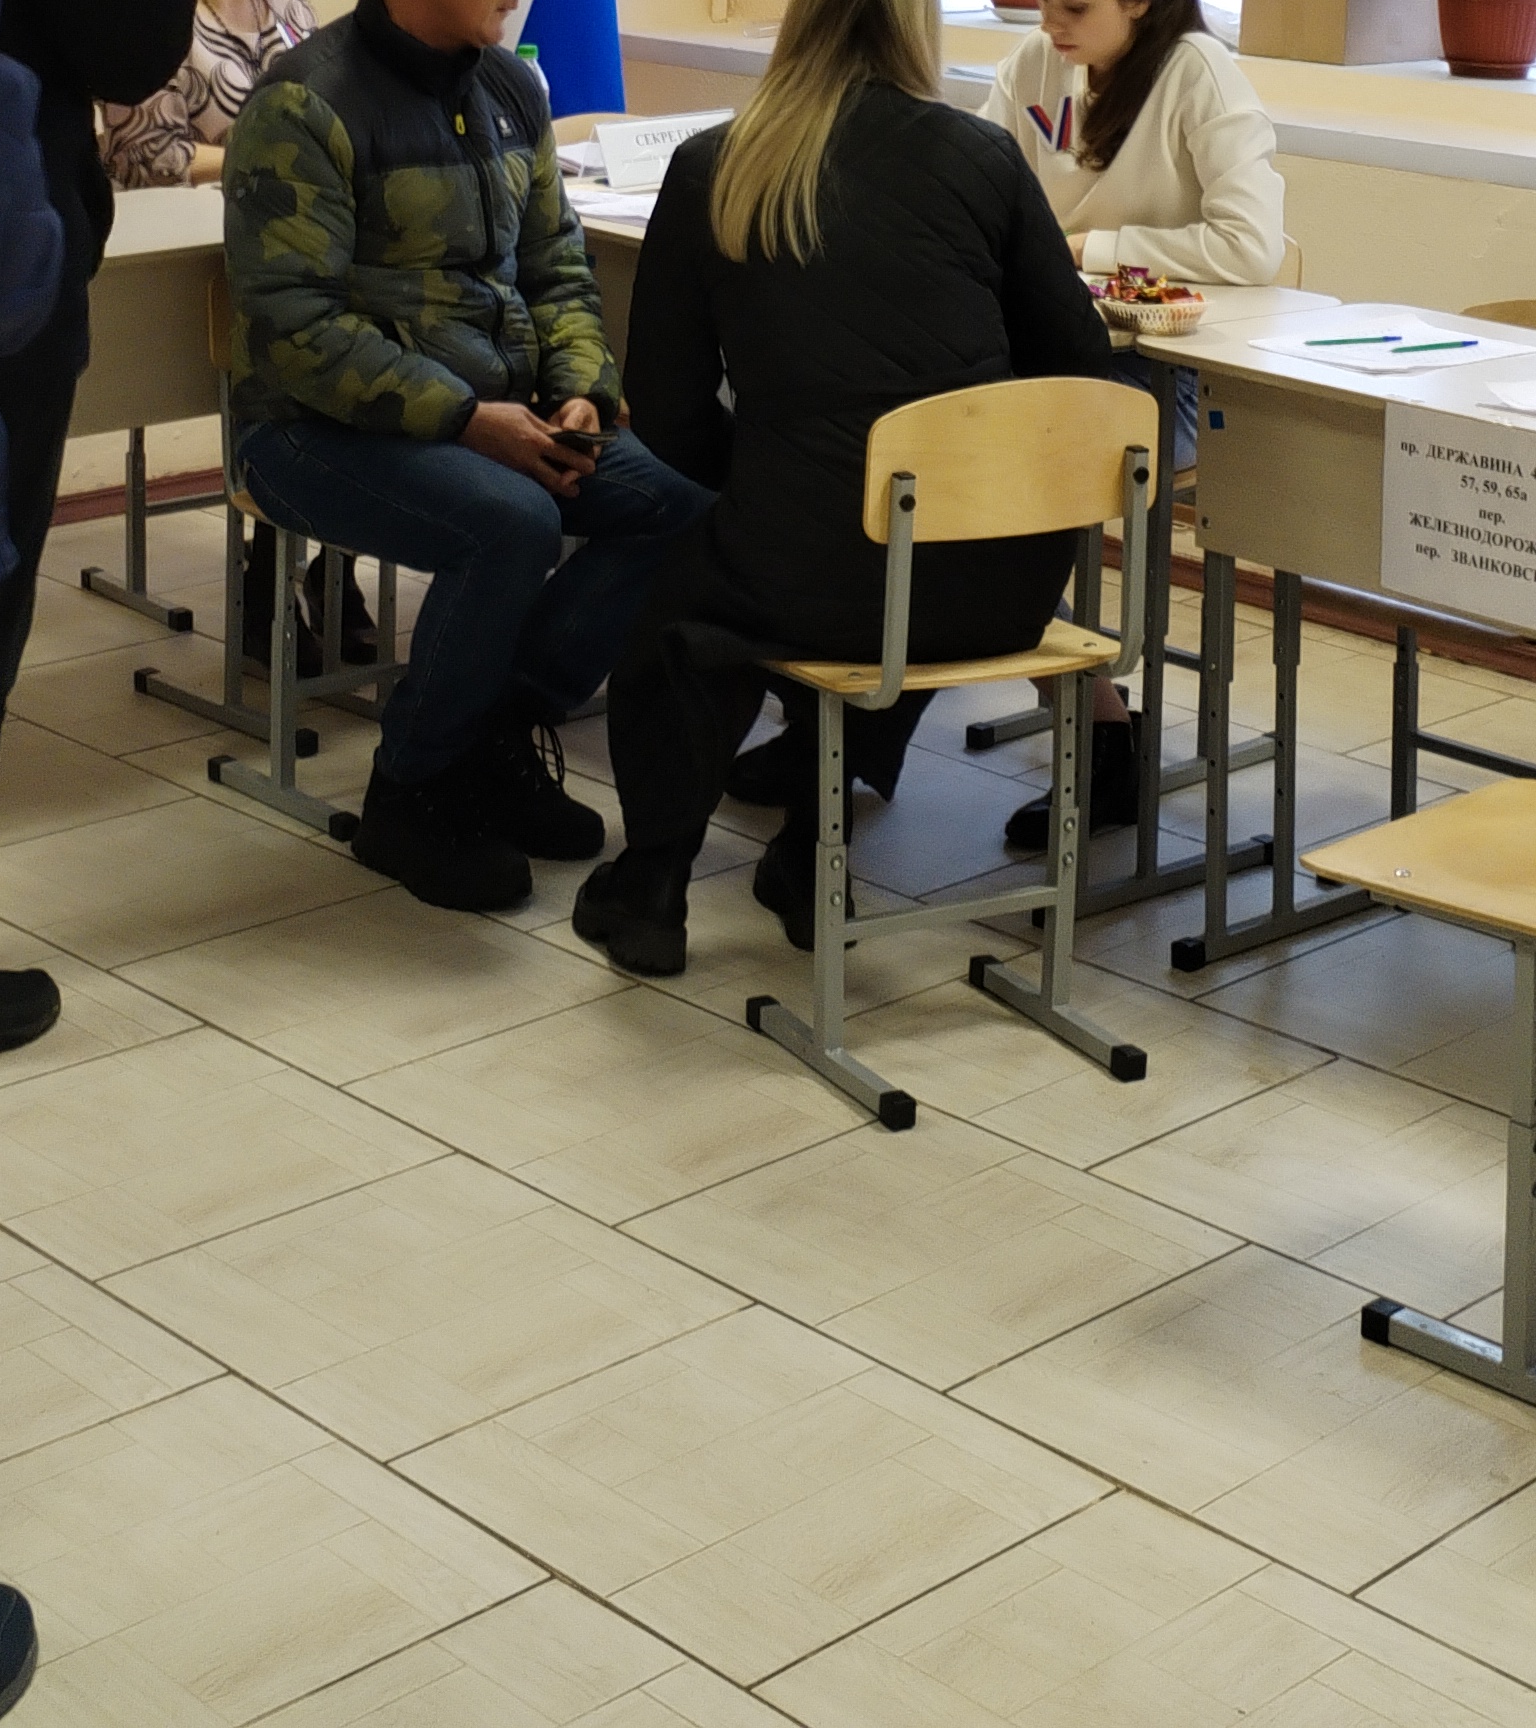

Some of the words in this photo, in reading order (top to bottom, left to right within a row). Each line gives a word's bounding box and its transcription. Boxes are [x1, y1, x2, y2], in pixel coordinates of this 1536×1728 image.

[1400, 440, 1420, 455] пр.
[1426, 443, 1524, 478] ДЕРЖАВИНА
[1460, 475, 1479, 494] 57,
[1482, 481, 1502, 499] 59,
[1505, 486, 1528, 502] 65а
[1478, 508, 1506, 525] пер.
[1415, 542, 1441, 560] пер.
